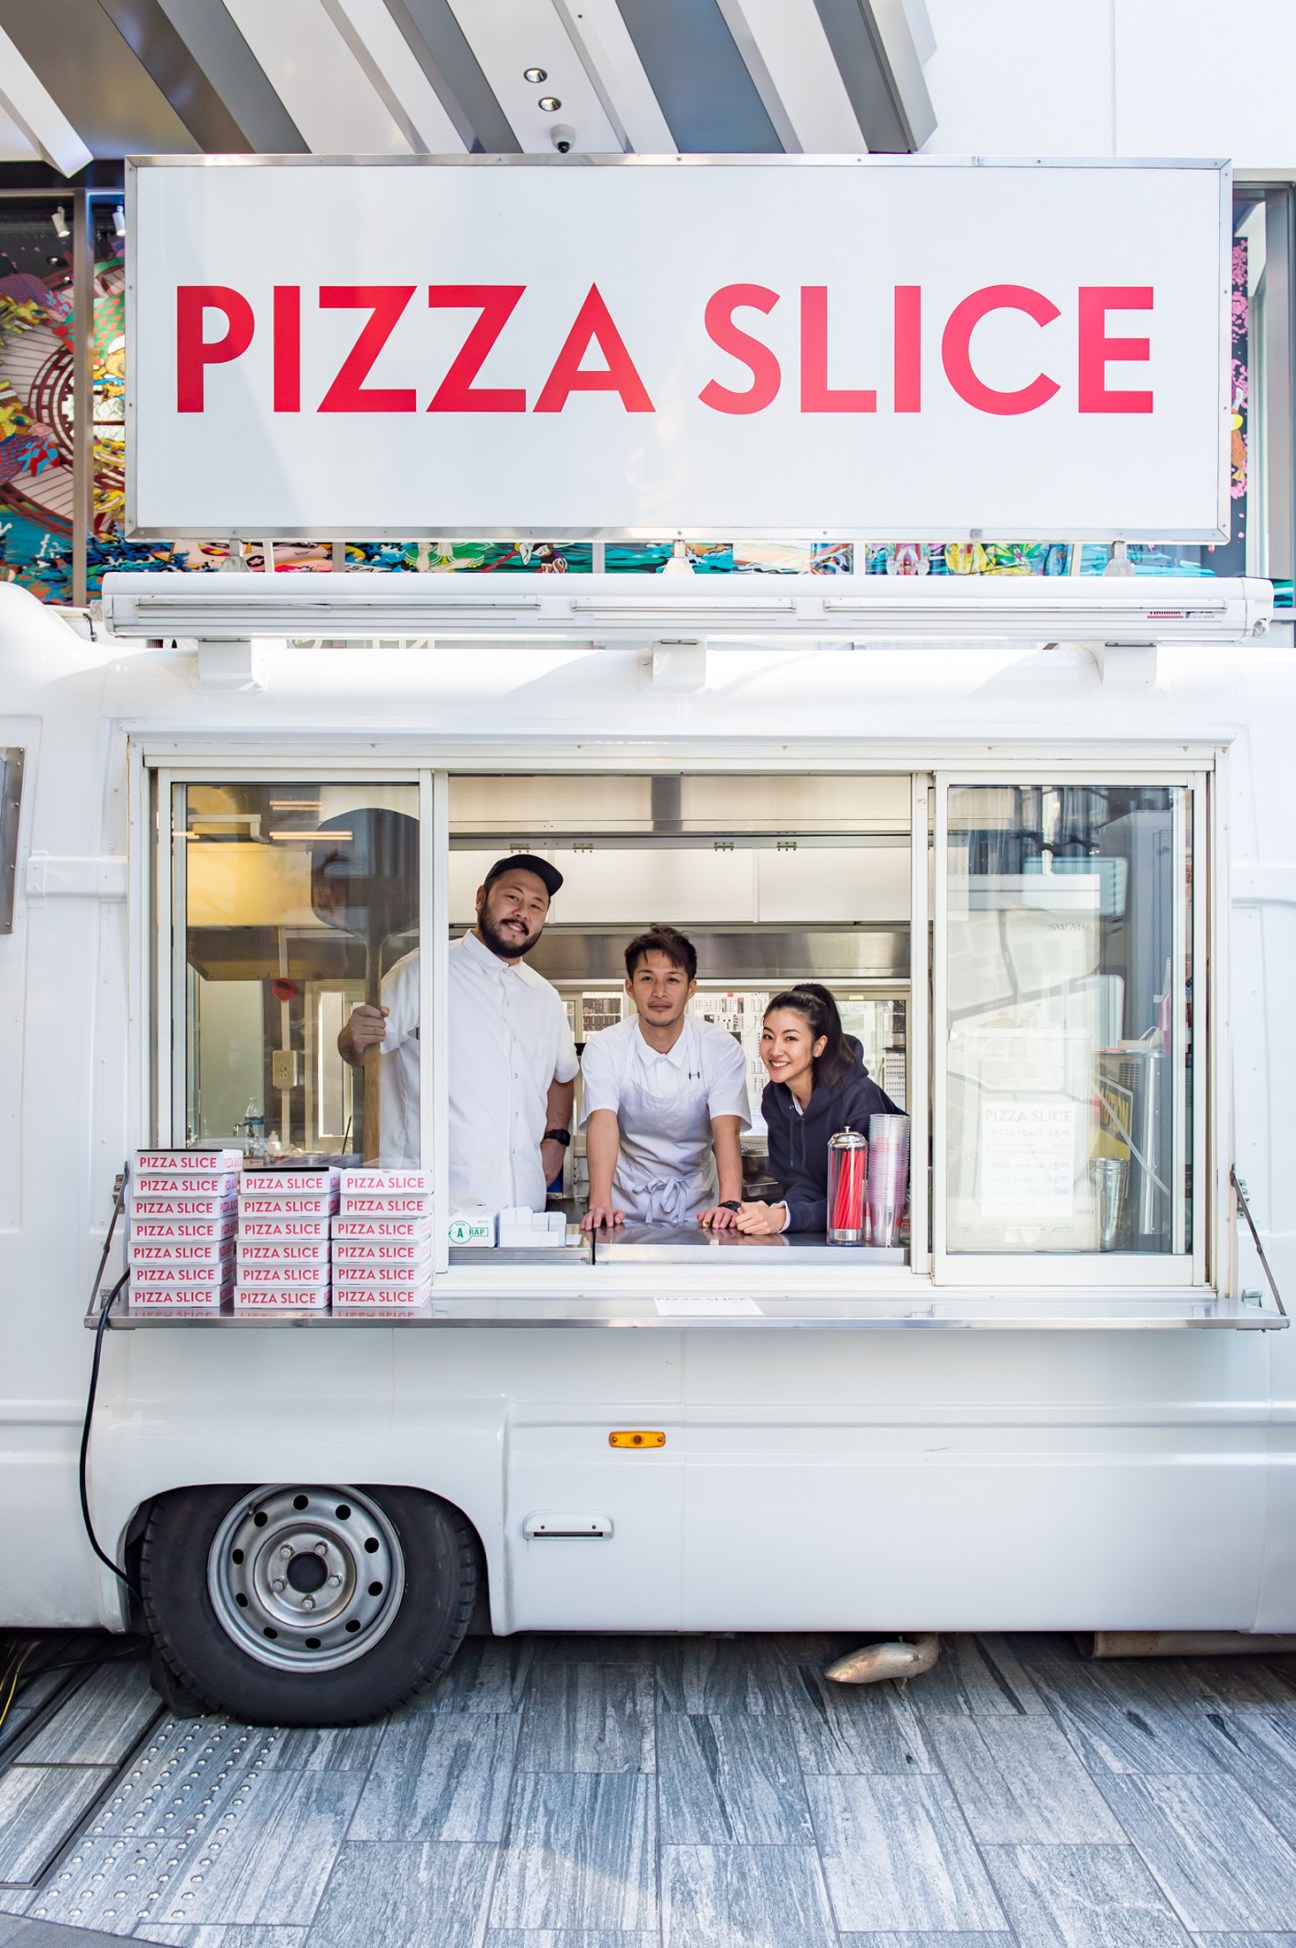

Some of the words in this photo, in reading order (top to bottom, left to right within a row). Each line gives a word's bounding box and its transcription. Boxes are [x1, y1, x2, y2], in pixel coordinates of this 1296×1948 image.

[177, 281, 654, 414] PIZZA
[699, 282, 1154, 416] SLICE
[984, 1109, 1028, 1122] PIZZA
[1031, 1109, 1072, 1122] SLICE
[140, 1157, 178, 1168] PIZZA
[181, 1157, 218, 1168] SLICE
[140, 1180, 179, 1191] PIZZA
[182, 1180, 219, 1191] SLICE
[246, 1178, 284, 1189] PIZZA
[287, 1178, 324, 1189] SLICE
[347, 1178, 385, 1188] PIZZA
[388, 1178, 425, 1188] SLICE
[136, 1202, 175, 1213] PIZZA
[178, 1202, 214, 1213] SLICE
[244, 1201, 282, 1212] PIZZA
[286, 1201, 322, 1212] SLICE
[346, 1200, 385, 1211] PIZZA
[388, 1200, 424, 1211] SLICE
[136, 1225, 175, 1236] PIZZA
[178, 1225, 214, 1236] SLICE
[245, 1224, 283, 1235] PIZZA
[286, 1224, 322, 1235] SLICE
[337, 1224, 376, 1234] PIZZA
[379, 1224, 415, 1234] SLICE
[134, 1248, 173, 1258] PIZZA
[175, 1248, 212, 1258] SLICE
[242, 1247, 281, 1258] PIZZA
[283, 1247, 320, 1258] SLICE
[337, 1247, 376, 1258] PIZZA
[379, 1247, 415, 1258] SLICE
[137, 1270, 176, 1281] PIZZA
[179, 1270, 215, 1281] SLICE
[243, 1270, 281, 1280] PIZZA
[284, 1270, 321, 1280] SLICE
[338, 1269, 376, 1280] PIZZA
[379, 1269, 415, 1280] SLICE
[135, 1292, 173, 1302] PIZZA
[176, 1292, 213, 1302] SLICE
[240, 1293, 278, 1304] PIZZA
[281, 1293, 318, 1304] SLICE
[338, 1291, 376, 1302] PIZZA
[379, 1291, 415, 1302] SLICE
